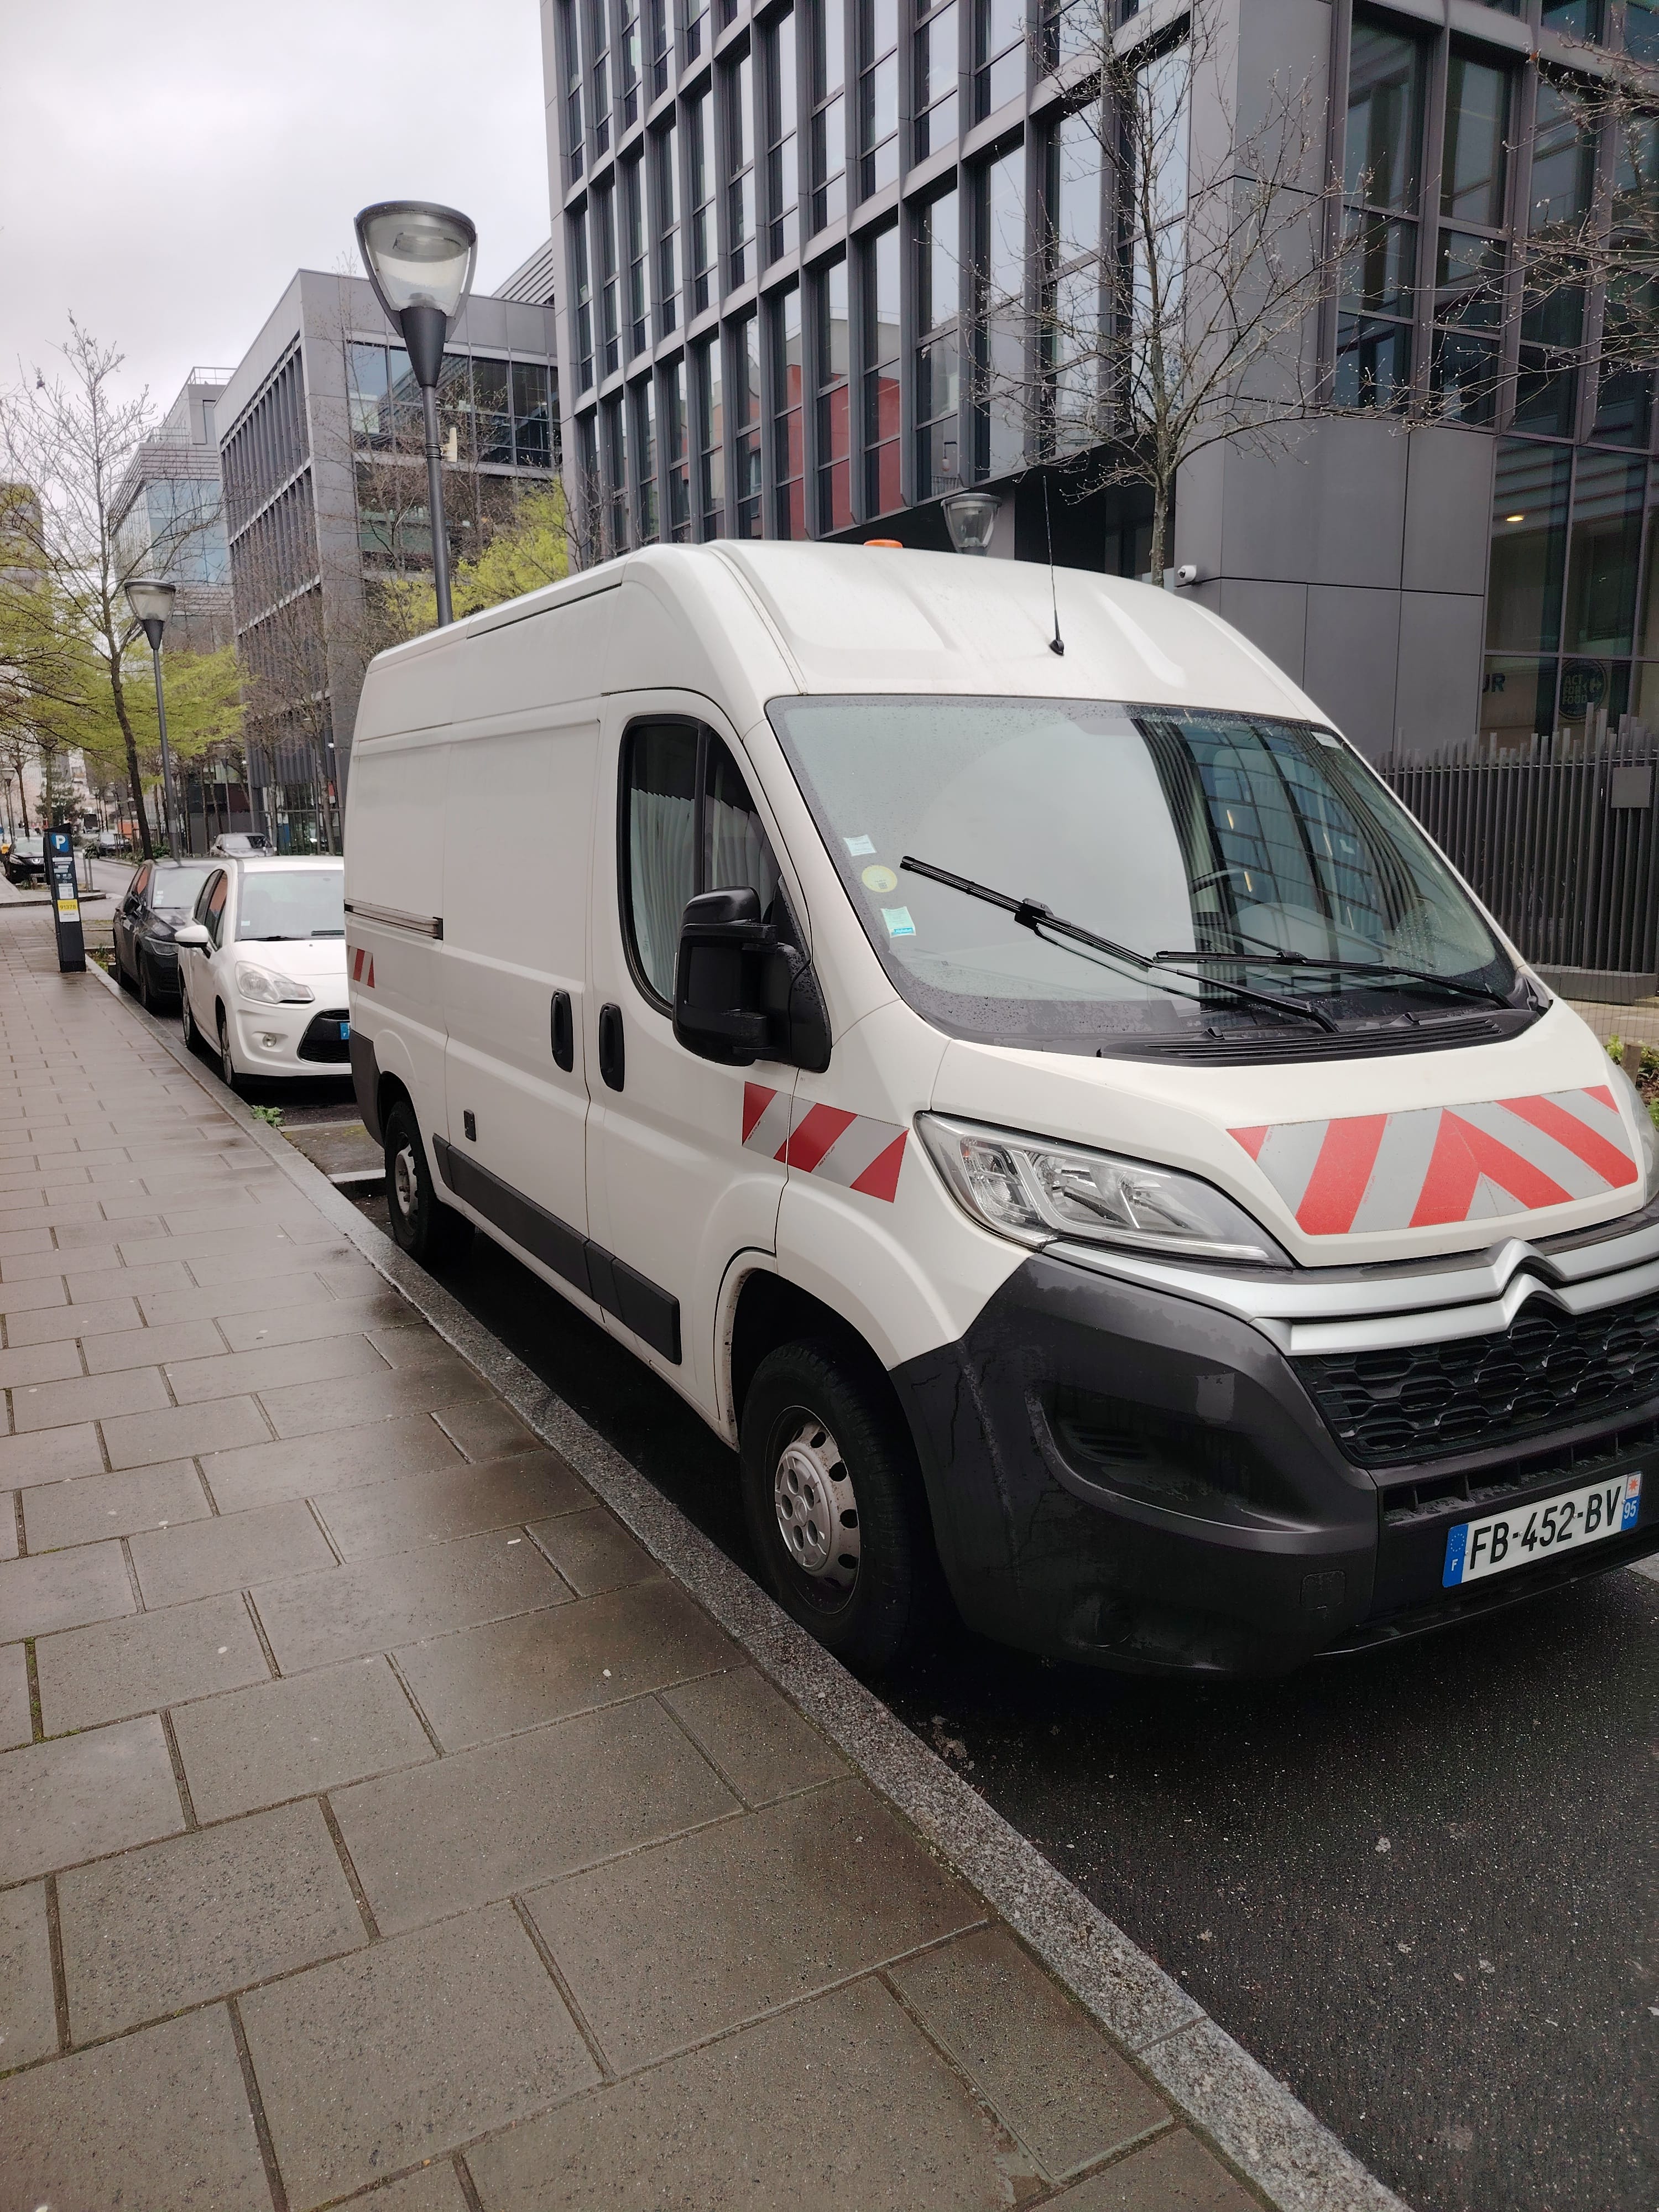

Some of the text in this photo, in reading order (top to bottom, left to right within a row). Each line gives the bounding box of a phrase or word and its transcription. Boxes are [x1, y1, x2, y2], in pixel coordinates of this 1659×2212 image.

[1562, 695, 1588, 705] FOOD
[56, 835, 65, 849] P
[1624, 1500, 1637, 1520] 95
[1469, 1486, 1621, 1570] FB-452-BV
[1451, 1558, 1458, 1571] F
